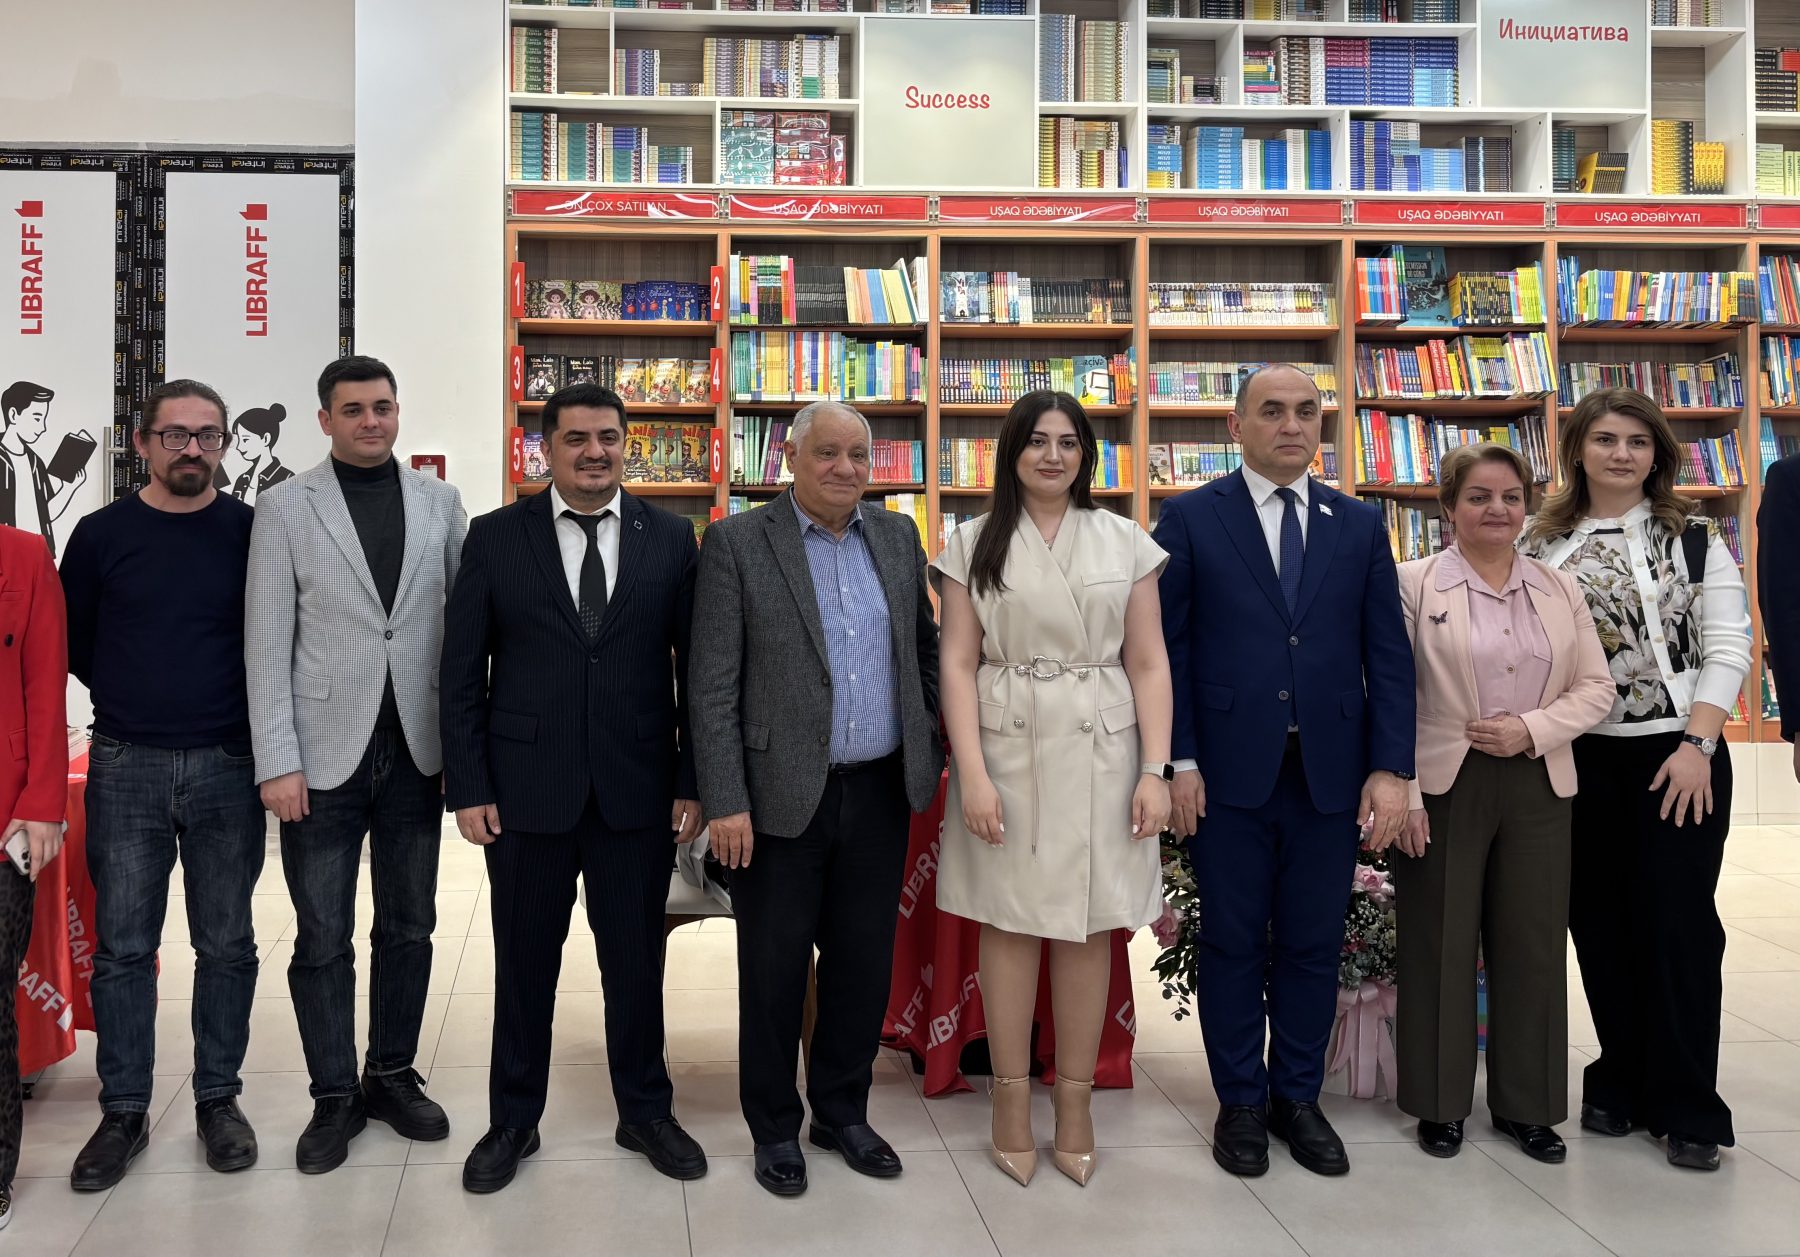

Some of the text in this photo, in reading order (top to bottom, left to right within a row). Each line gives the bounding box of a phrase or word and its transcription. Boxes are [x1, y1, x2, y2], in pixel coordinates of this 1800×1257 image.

[1499, 18, 1629, 43] Инициатива
[905, 86, 990, 109] Success
[990, 204, 1082, 217] UŞAQ ƏDƏBİYYATI
[1198, 205, 1289, 217] UŞAQ ƏDƏBİYYATI
[1398, 208, 1504, 221] UŞAQ ƏDƏBİYYATI
[1595, 210, 1701, 223] UŞAQ ƏDƏBİYYATI
[20, 223, 44, 335] LIBRAFF
[246, 226, 268, 337] LIBRAFF
[515, 272, 520, 306] 1
[713, 276, 721, 310] 2
[514, 356, 521, 390] 3
[713, 358, 721, 392] 4
[513, 438, 520, 472] 5
[713, 440, 721, 473] 6
[898, 837, 942, 919] LIBRA
[67, 886, 95, 979] BRAFF
[18, 960, 66, 1012] RAFF
